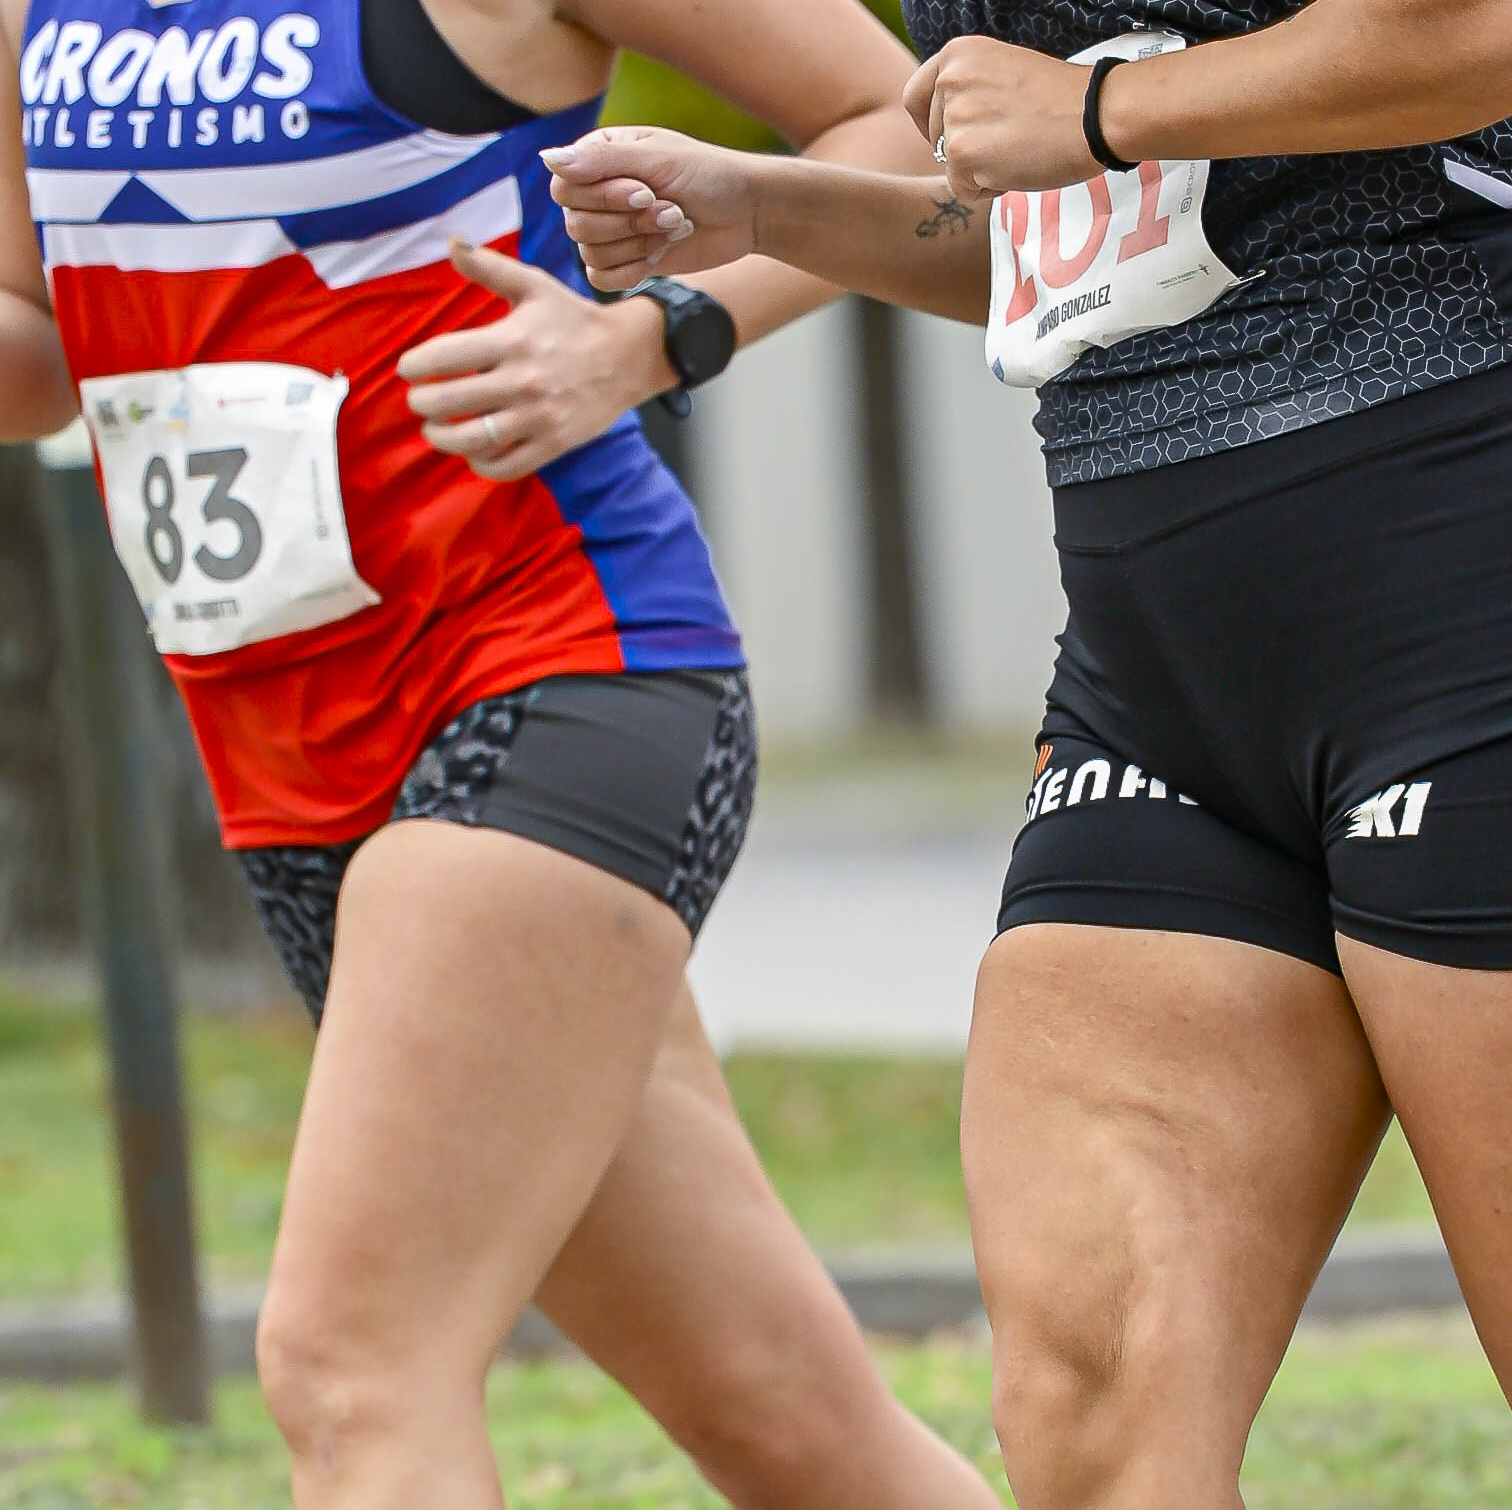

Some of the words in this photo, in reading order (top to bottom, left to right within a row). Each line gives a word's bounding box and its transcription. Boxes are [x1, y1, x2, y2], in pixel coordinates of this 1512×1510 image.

[19, 12, 320, 107] CRONOS
[1061, 284, 1111, 323] GONZALEZ
[143, 447, 262, 585] 83
